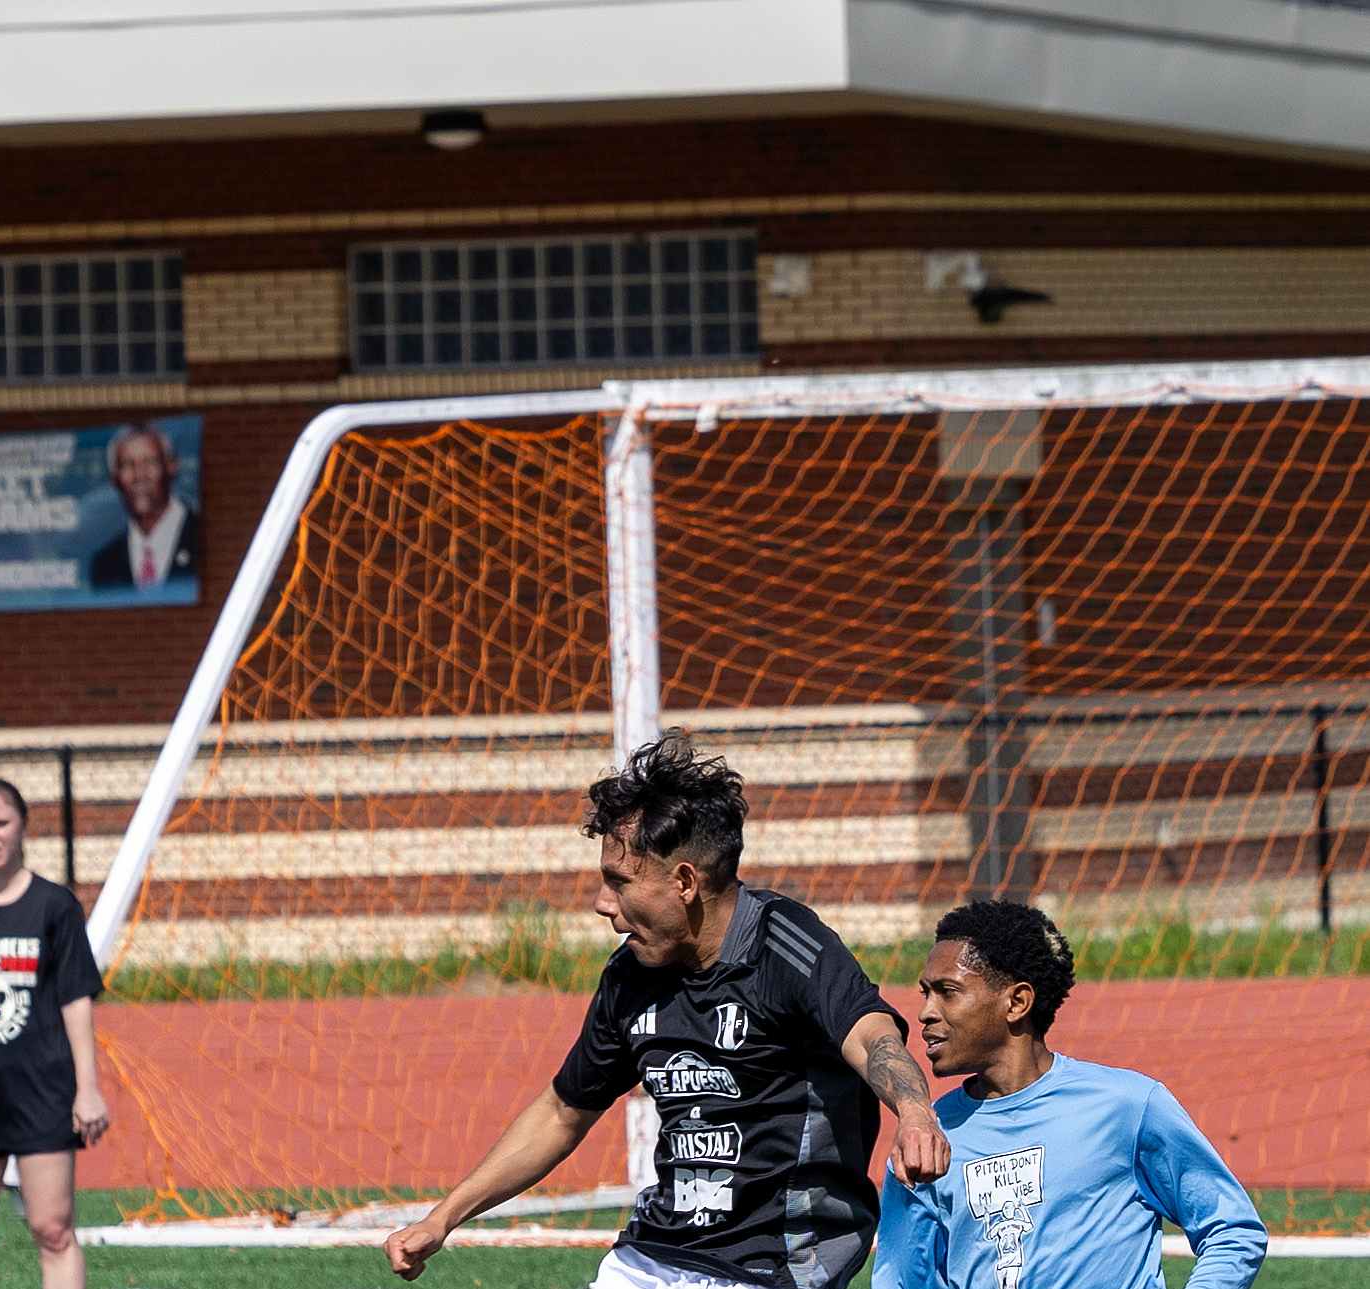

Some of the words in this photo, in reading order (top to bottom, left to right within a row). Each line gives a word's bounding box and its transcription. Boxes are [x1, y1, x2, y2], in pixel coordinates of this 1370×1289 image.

[648, 1071, 670, 1093] TE
[671, 1070, 738, 1095] APUESTO
[975, 1160, 1006, 1178] PITCH
[1009, 1152, 1038, 1170] DONT
[673, 1167, 735, 1213] BIG
[994, 1171, 1022, 1188] KILL
[978, 1190, 993, 1207] MY
[1012, 1181, 1035, 1199] VIBE
[686, 1211, 727, 1227] OLA
